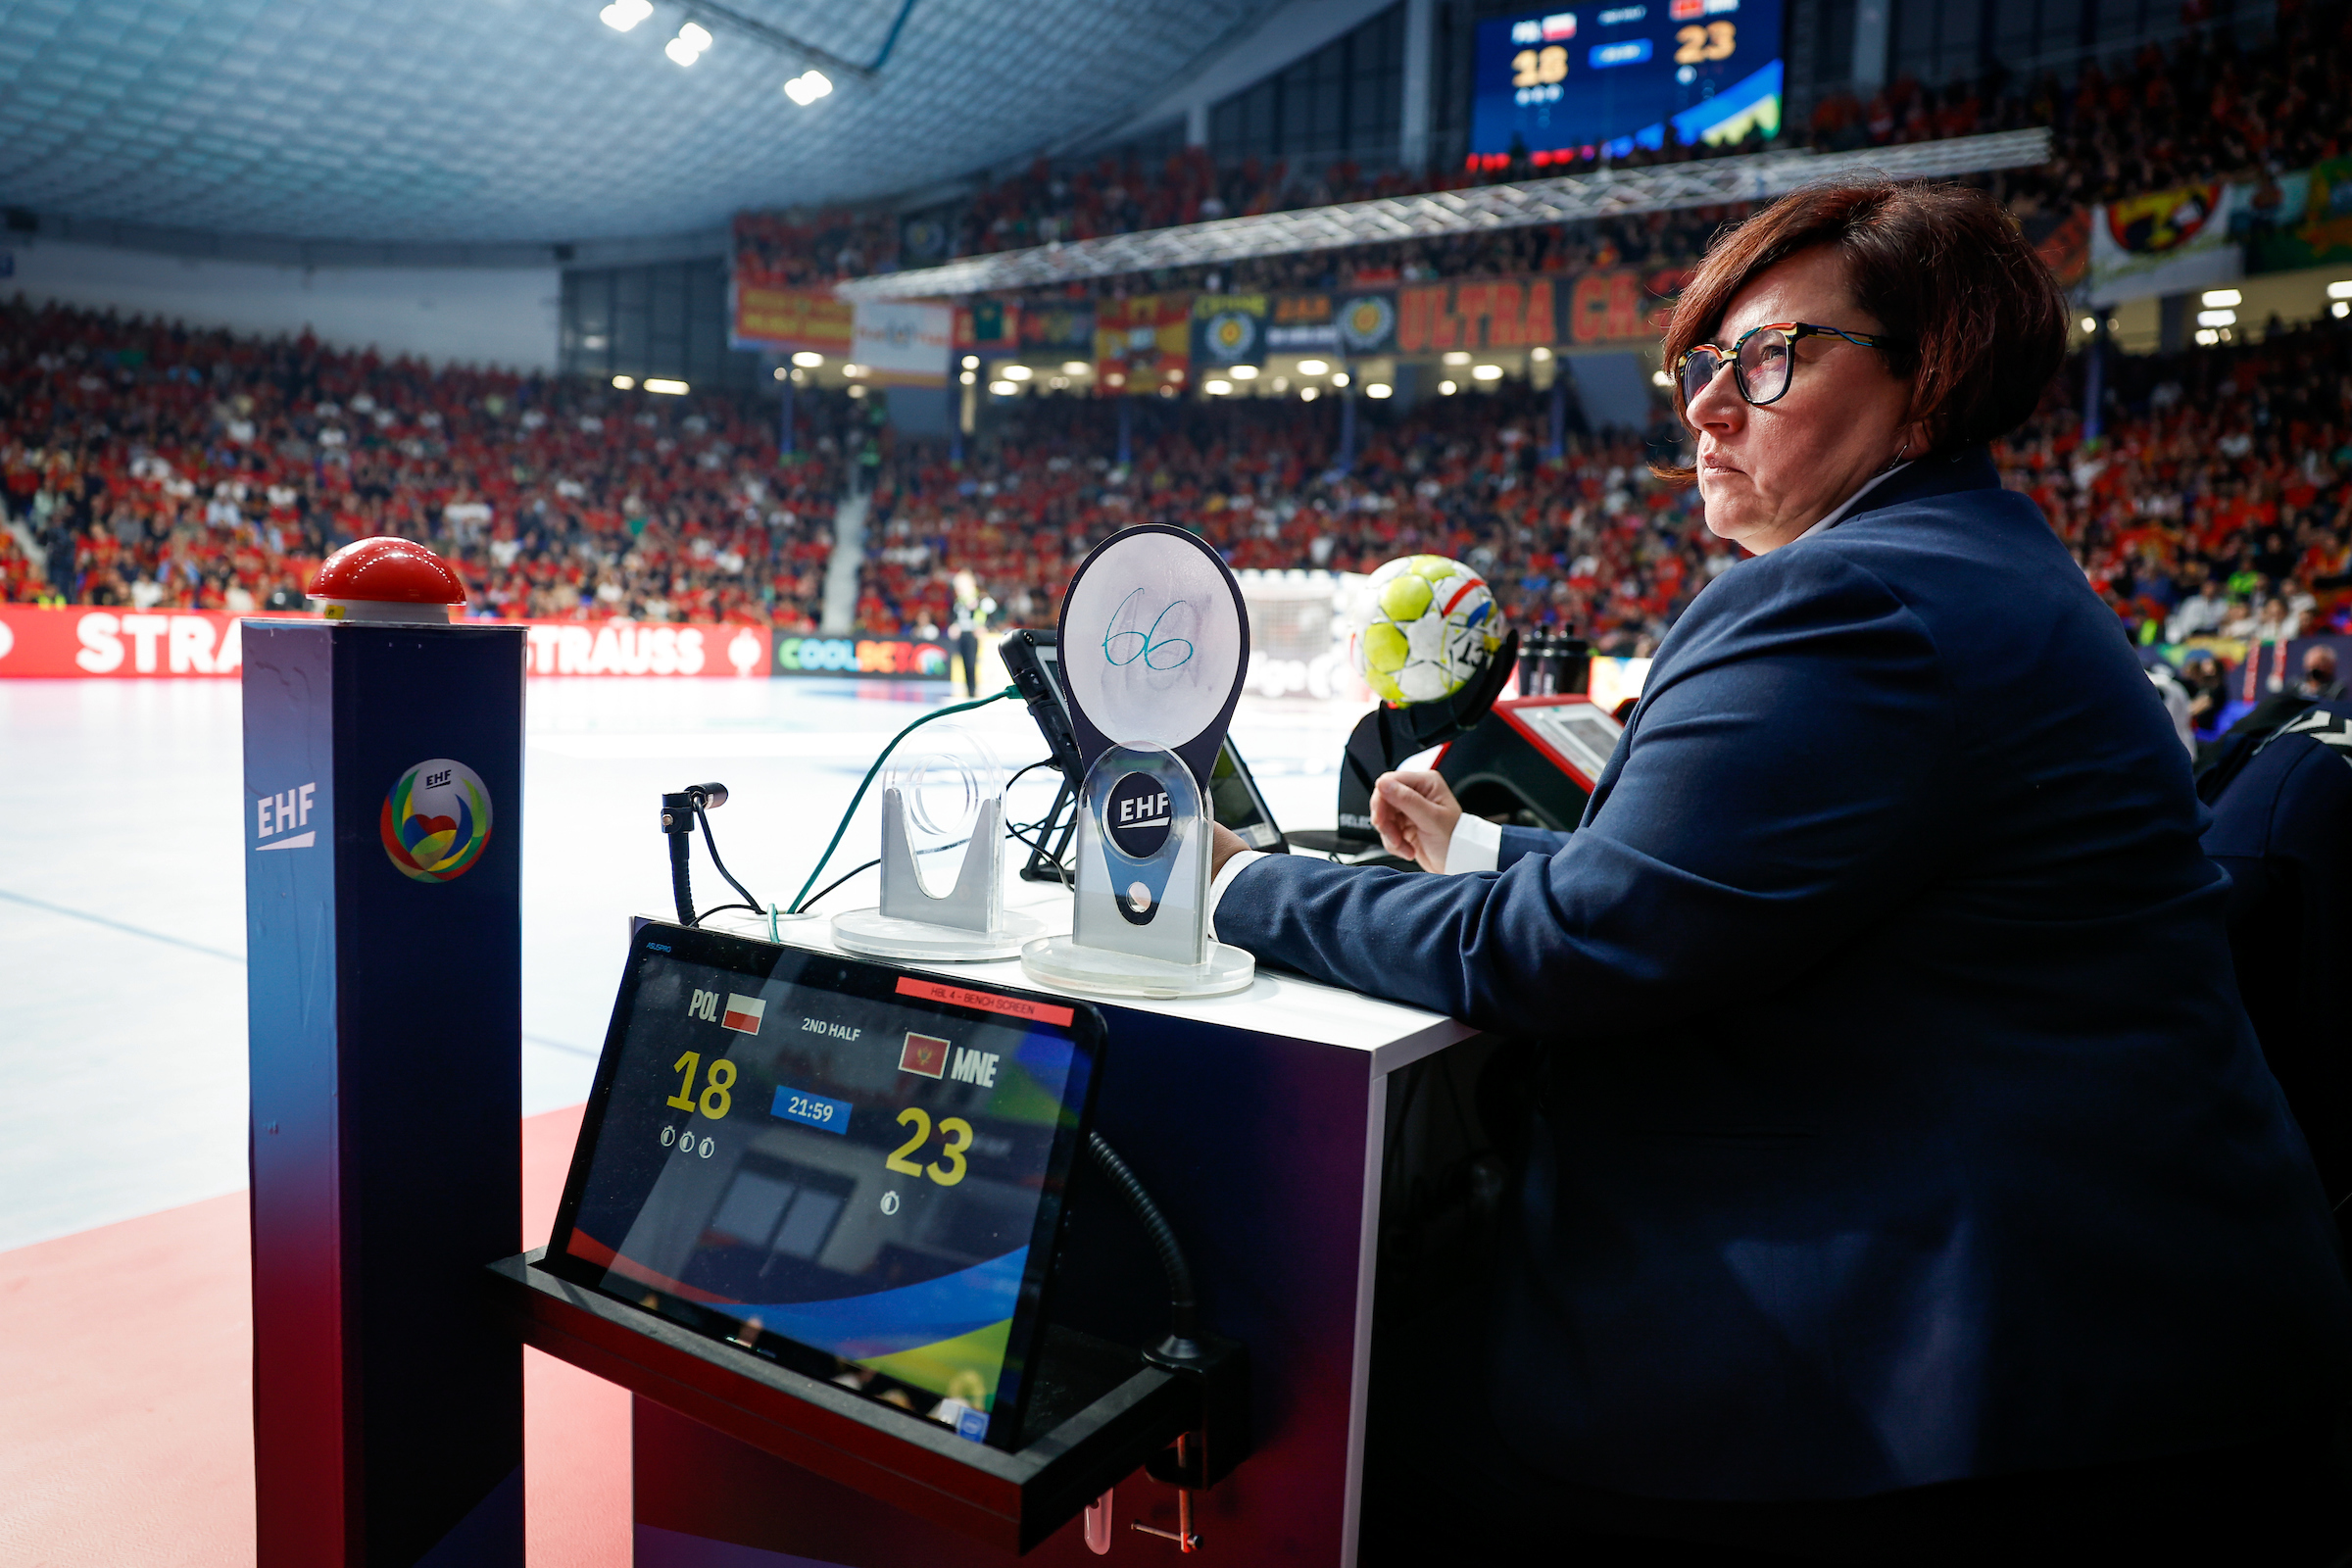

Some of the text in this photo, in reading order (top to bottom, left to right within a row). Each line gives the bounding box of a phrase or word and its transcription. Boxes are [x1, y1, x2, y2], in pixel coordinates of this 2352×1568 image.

[1674, 21, 1737, 65] 23
[1511, 45, 1568, 87] 18
[1398, 278, 1555, 350] ULTRA
[1102, 587, 1194, 671] 66
[426, 769, 452, 787] EHF
[258, 782, 316, 839] EHF
[1119, 792, 1169, 822] EHF
[688, 989, 719, 1022] POL
[931, 987, 947, 998] HBL
[963, 993, 994, 1006] BENCH
[996, 1000, 1035, 1014] SCREEN
[802, 1017, 861, 1042] 2ND HALF
[666, 1050, 737, 1120] 18
[951, 1047, 1000, 1088] MNE
[788, 1097, 833, 1123] 21:59
[885, 1106, 974, 1187] 23
